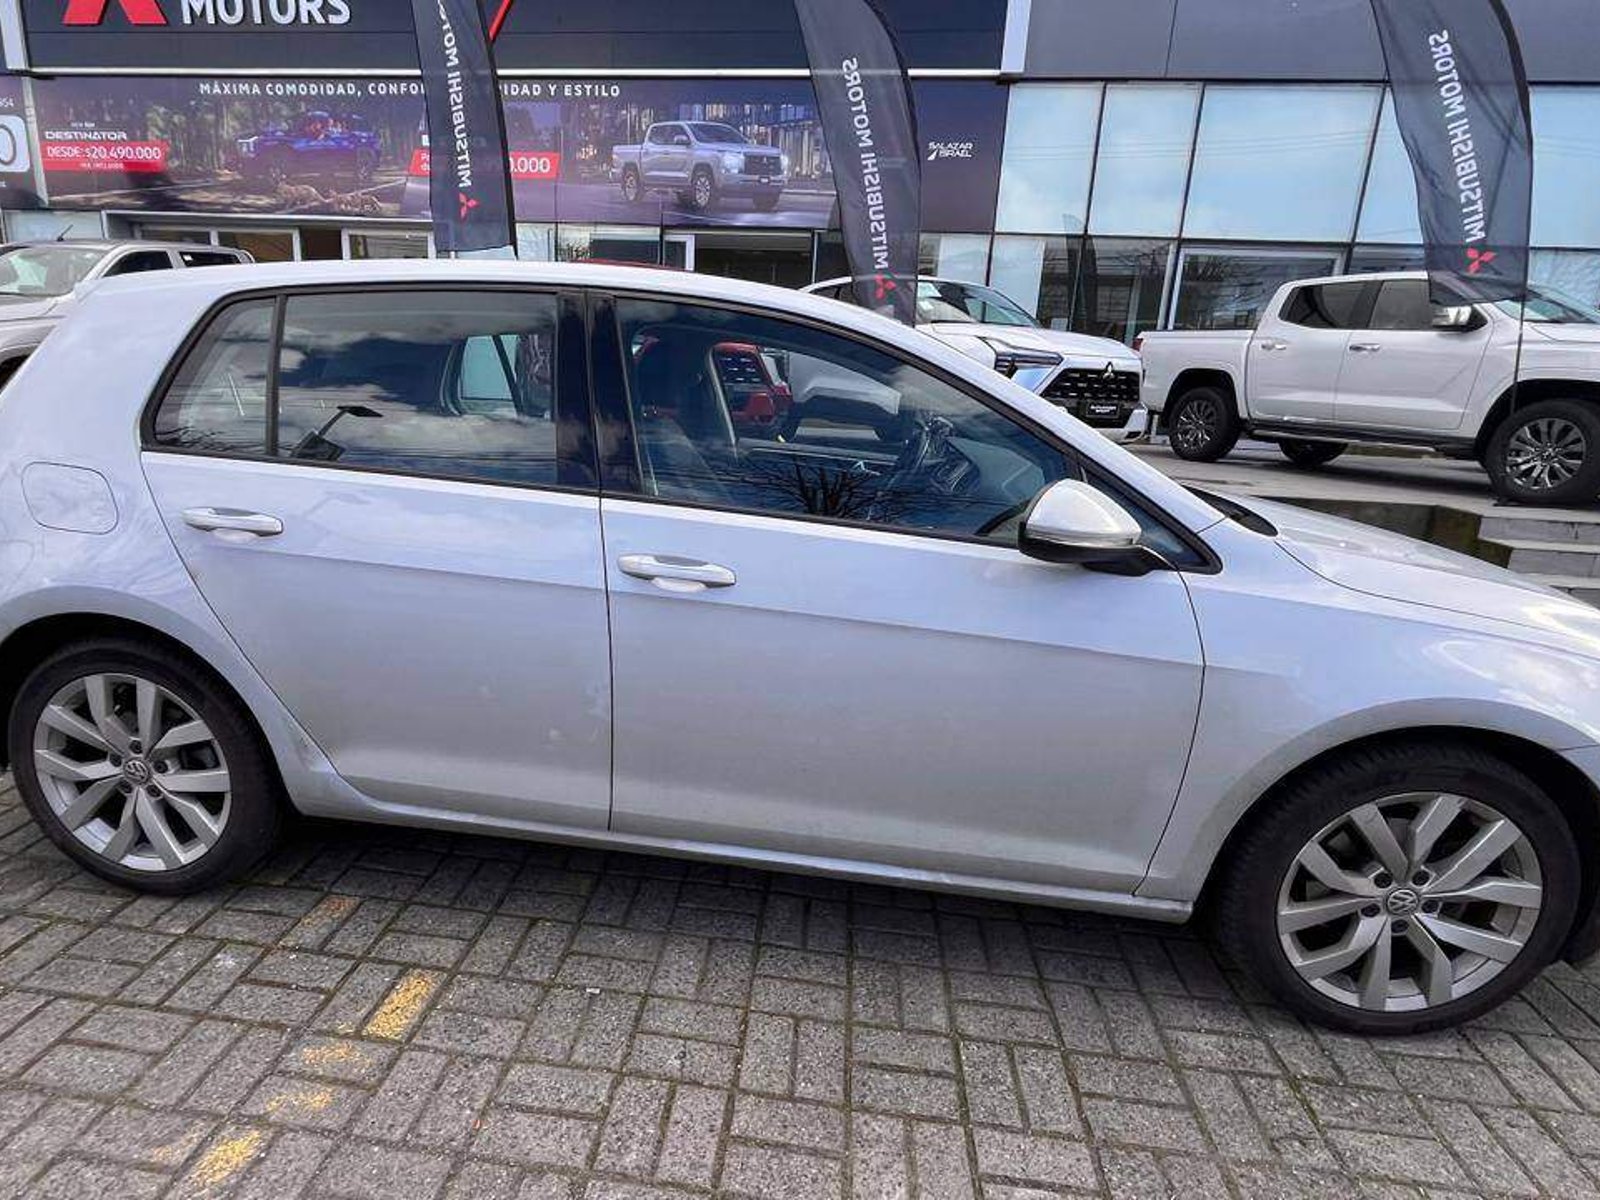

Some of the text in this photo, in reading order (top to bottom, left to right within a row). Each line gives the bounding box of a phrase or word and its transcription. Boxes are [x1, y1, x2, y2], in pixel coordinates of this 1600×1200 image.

[199, 81, 261, 96] MÁXIMA
[265, 83, 362, 97] COMODIDAD,
[548, 84, 557, 96] Y
[563, 84, 620, 97] ESTILO
[45, 131, 128, 140] DESTINATOR
